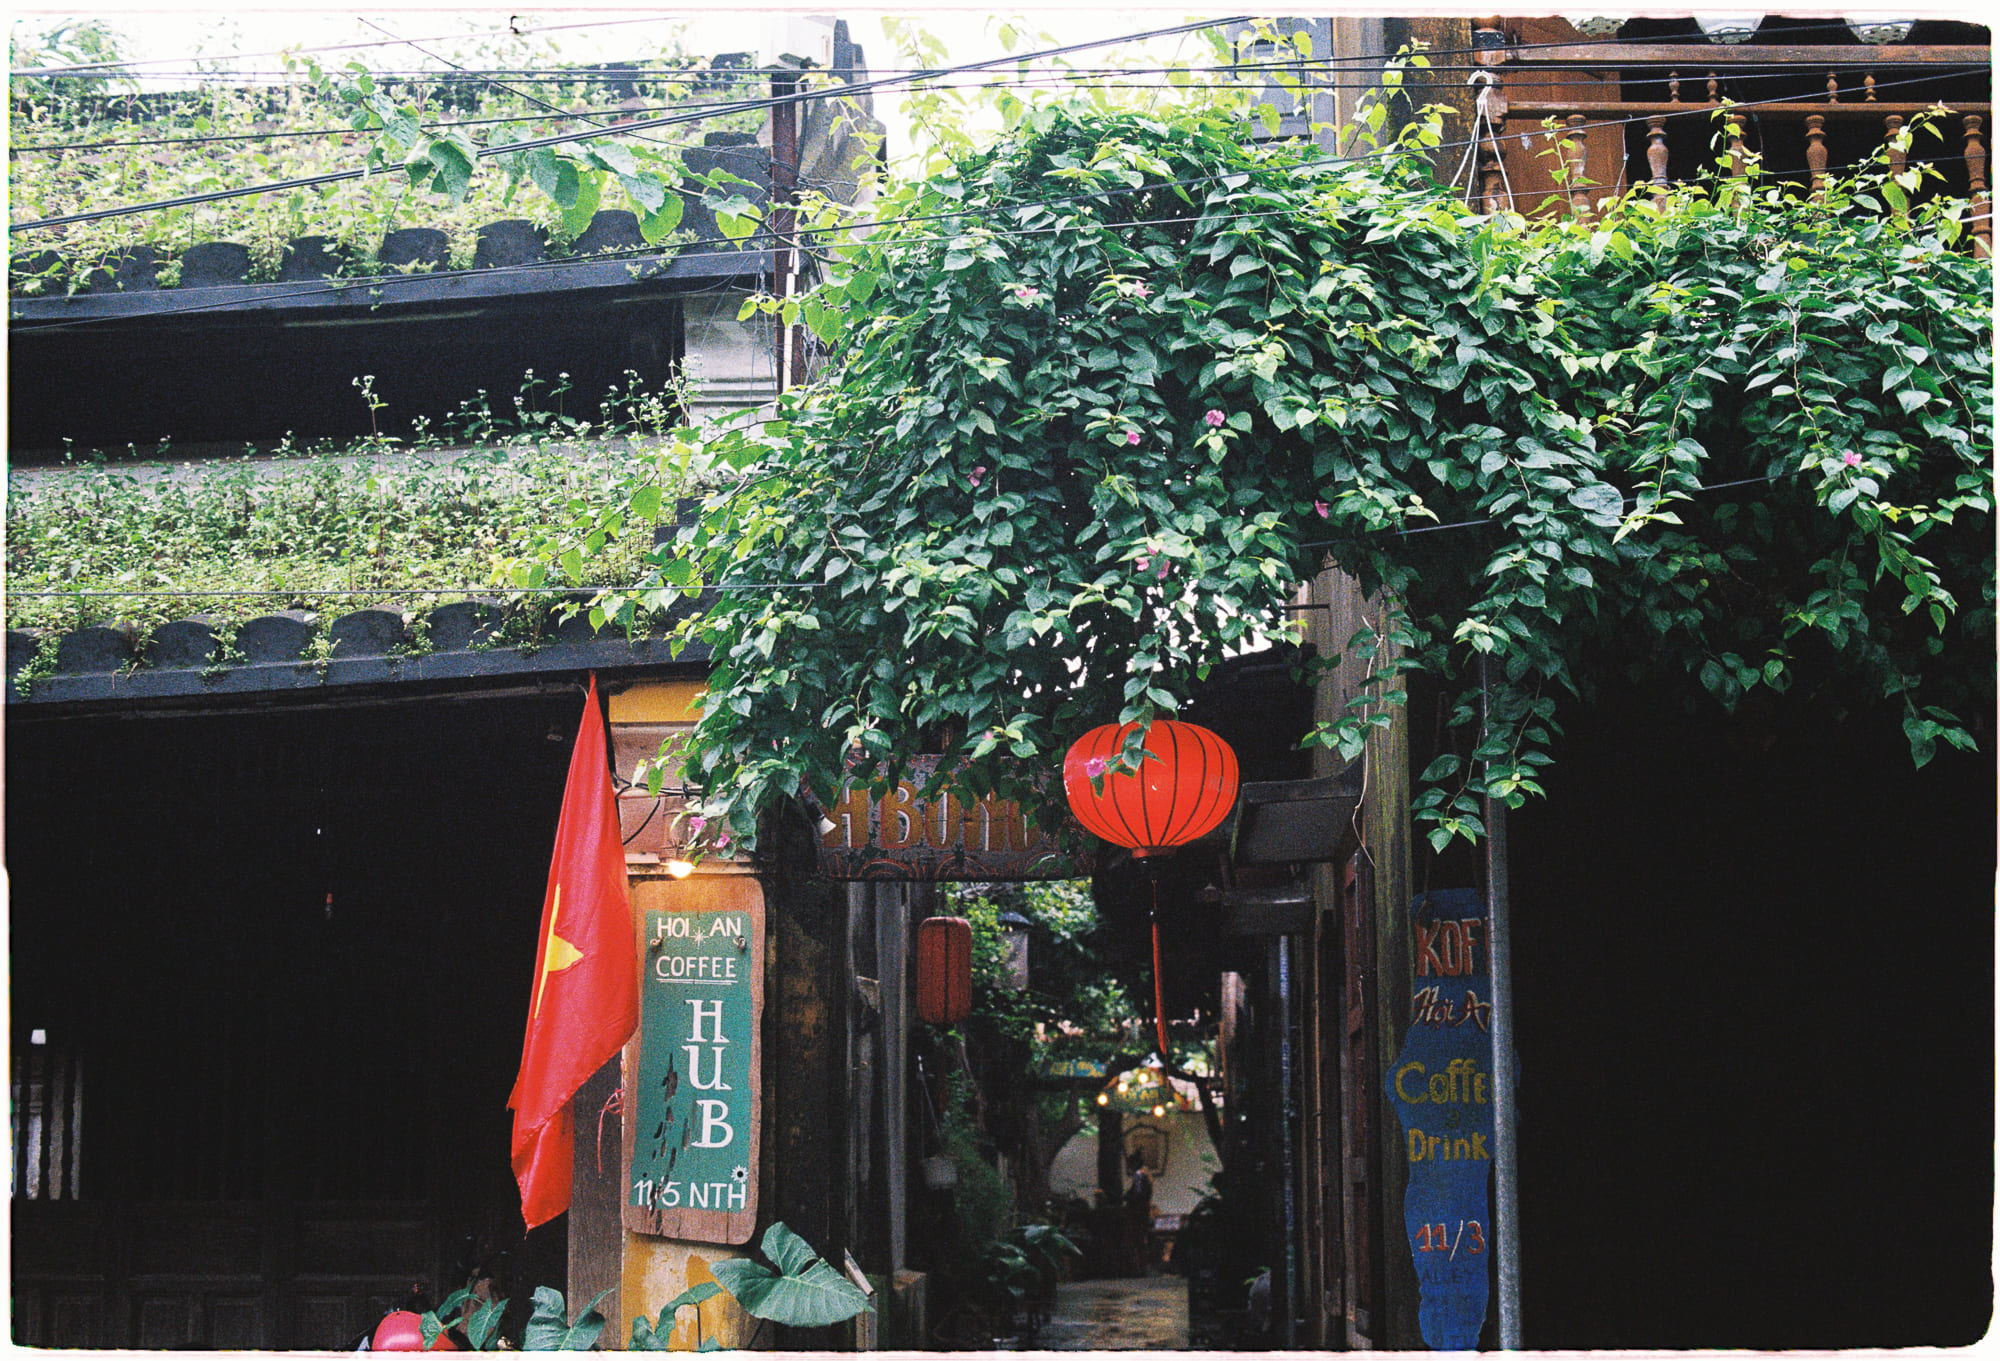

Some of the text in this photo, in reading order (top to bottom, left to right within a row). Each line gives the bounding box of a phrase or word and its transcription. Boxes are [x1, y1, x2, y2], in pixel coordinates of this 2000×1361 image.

[657, 916, 742, 938] HOI AN
[655, 956, 737, 978] COFFEE
[681, 999, 734, 1149] HUB
[1395, 1058, 1495, 1104] Coffe
[1408, 1127, 1490, 1162] Drink
[689, 1182, 747, 1210] NTH
[1415, 1219, 1486, 1262] 11/3
